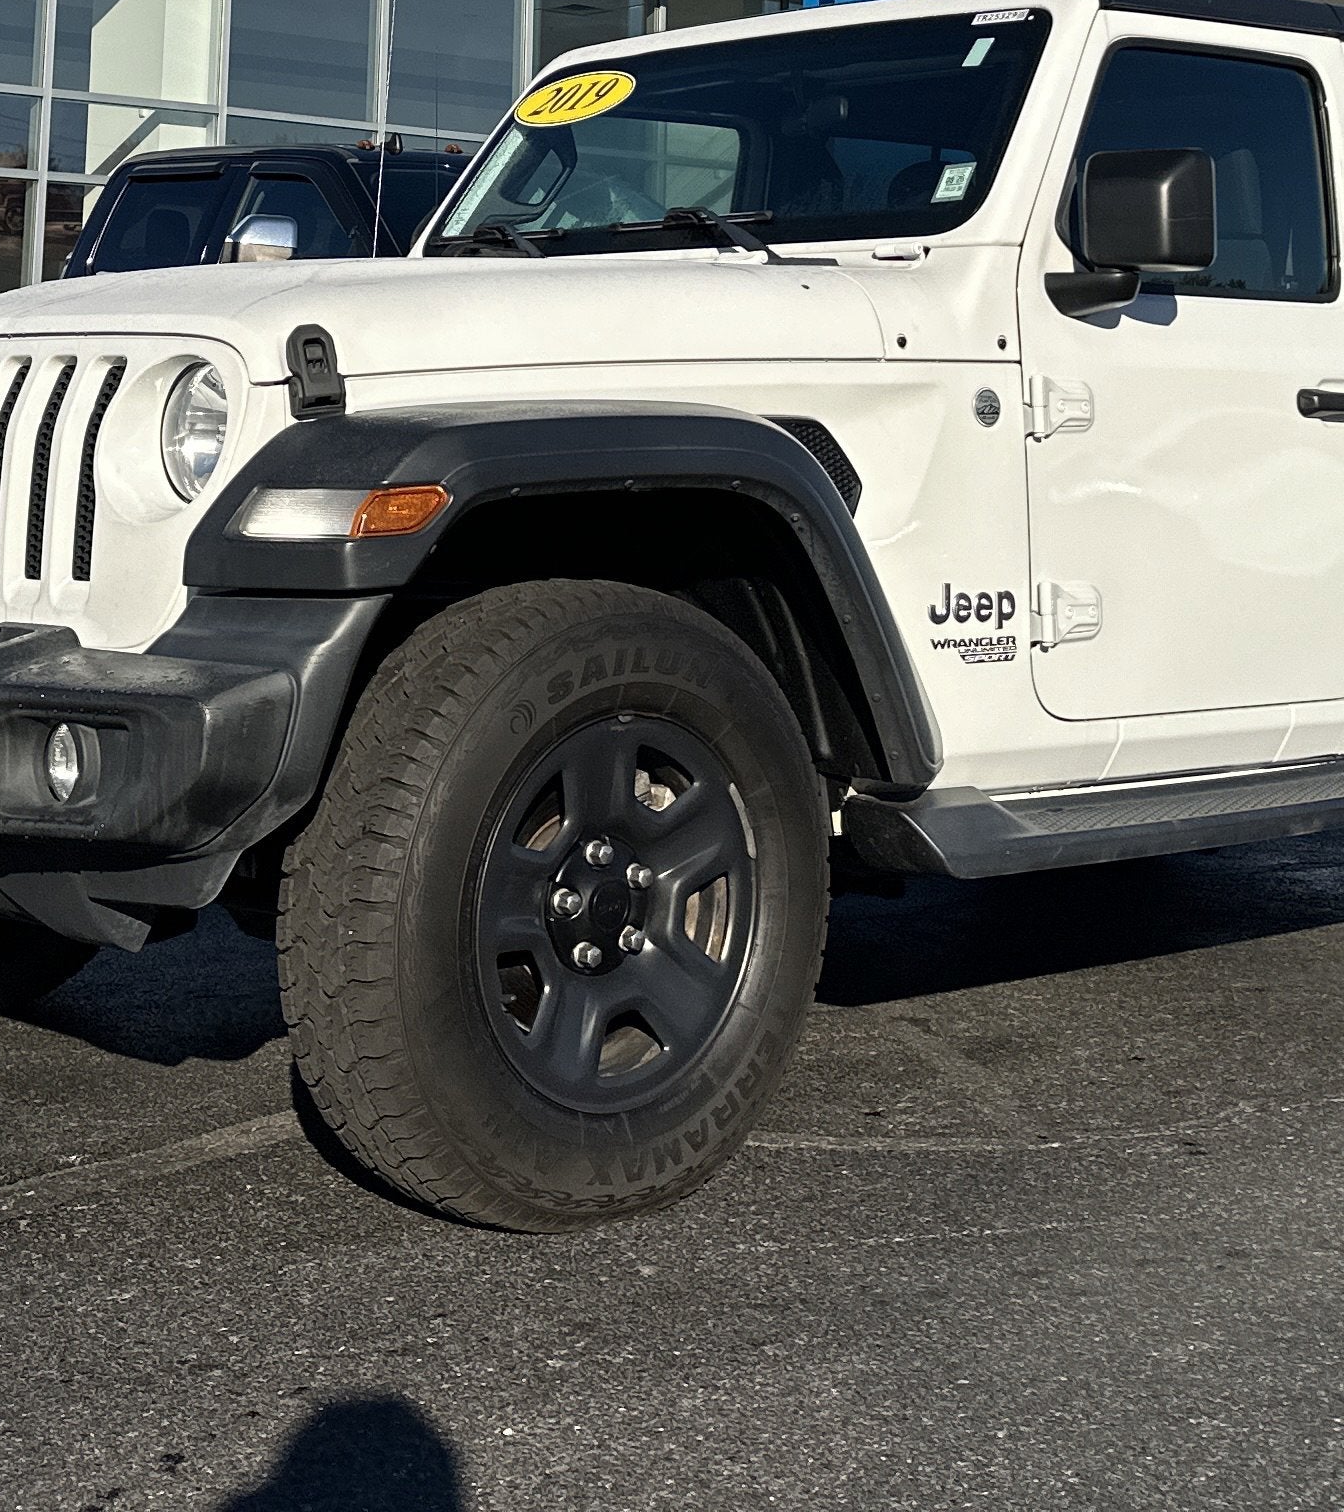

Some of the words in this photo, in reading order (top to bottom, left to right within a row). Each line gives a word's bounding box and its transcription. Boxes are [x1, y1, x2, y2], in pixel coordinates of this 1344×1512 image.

[527, 77, 619, 117] 2019
[927, 582, 1016, 630] Jeep
[930, 636, 1016, 650] WRANGLER
[964, 653, 1014, 663] SPORT
[546, 647, 716, 705] SAILUN
[586, 1014, 780, 1187] ERRAMAX
